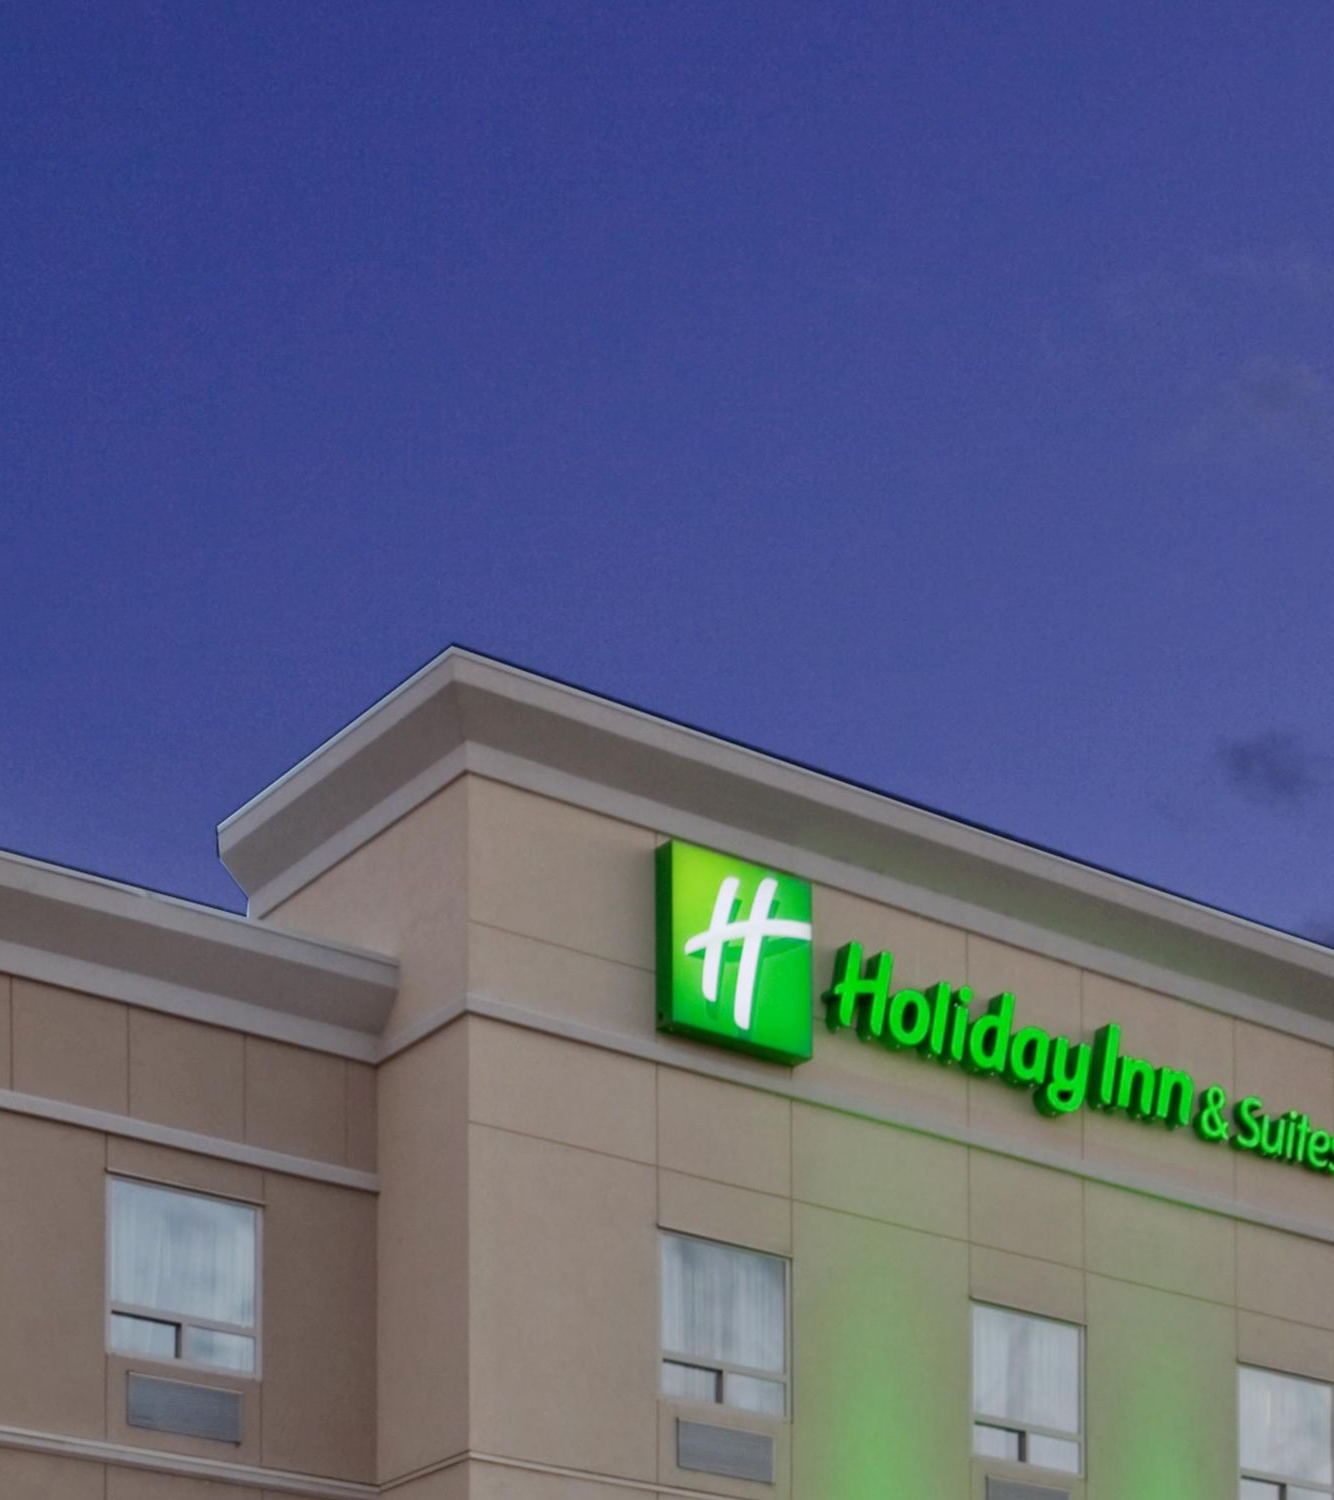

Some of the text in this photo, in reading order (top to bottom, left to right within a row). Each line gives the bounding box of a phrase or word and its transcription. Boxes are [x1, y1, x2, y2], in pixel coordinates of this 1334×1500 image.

[824, 942, 1091, 1116] Holiday
[1095, 1024, 1193, 1127] Inn
[1194, 1086, 1229, 1142] &
